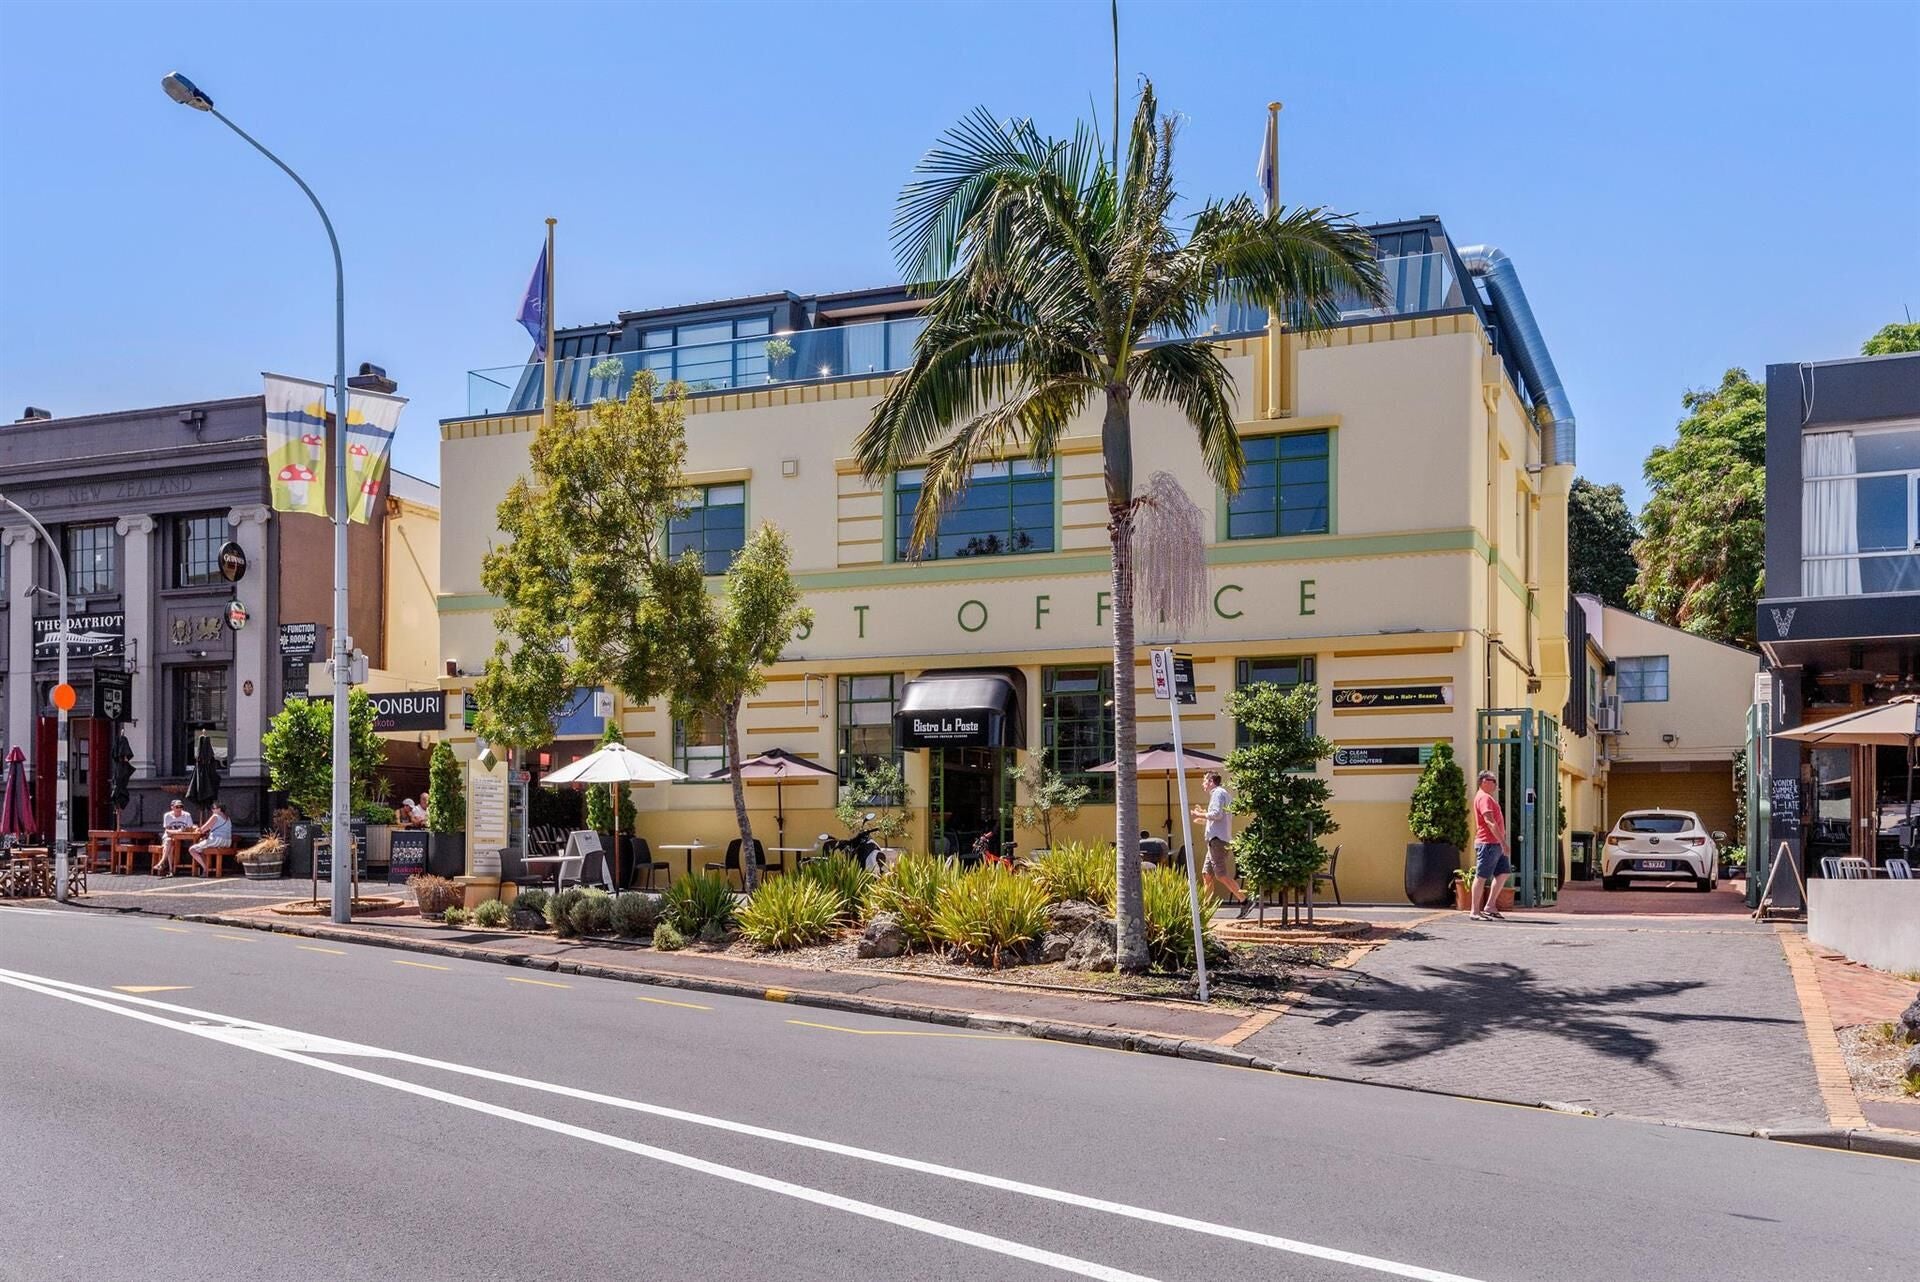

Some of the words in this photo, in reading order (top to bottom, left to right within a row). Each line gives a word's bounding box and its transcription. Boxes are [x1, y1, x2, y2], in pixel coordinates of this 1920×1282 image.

[29, 490, 50, 506] OF
[67, 486, 100, 503] NEW
[116, 477, 193, 498] ZEALAND
[34, 620, 61, 632] THE
[66, 615, 124, 632] PATRIOT
[287, 624, 315, 633] FUNCTION
[1770, 607, 1797, 637] V
[289, 635, 307, 643] ROOM
[1335, 690, 1379, 704] Honey
[368, 696, 440, 715] DONBURI
[913, 719, 939, 732] Bistro
[955, 718, 979, 732] Poste
[1772, 779, 1796, 787] VONDEL
[1772, 786, 1798, 794] SUMMER
[391, 866, 424, 874] makoto
